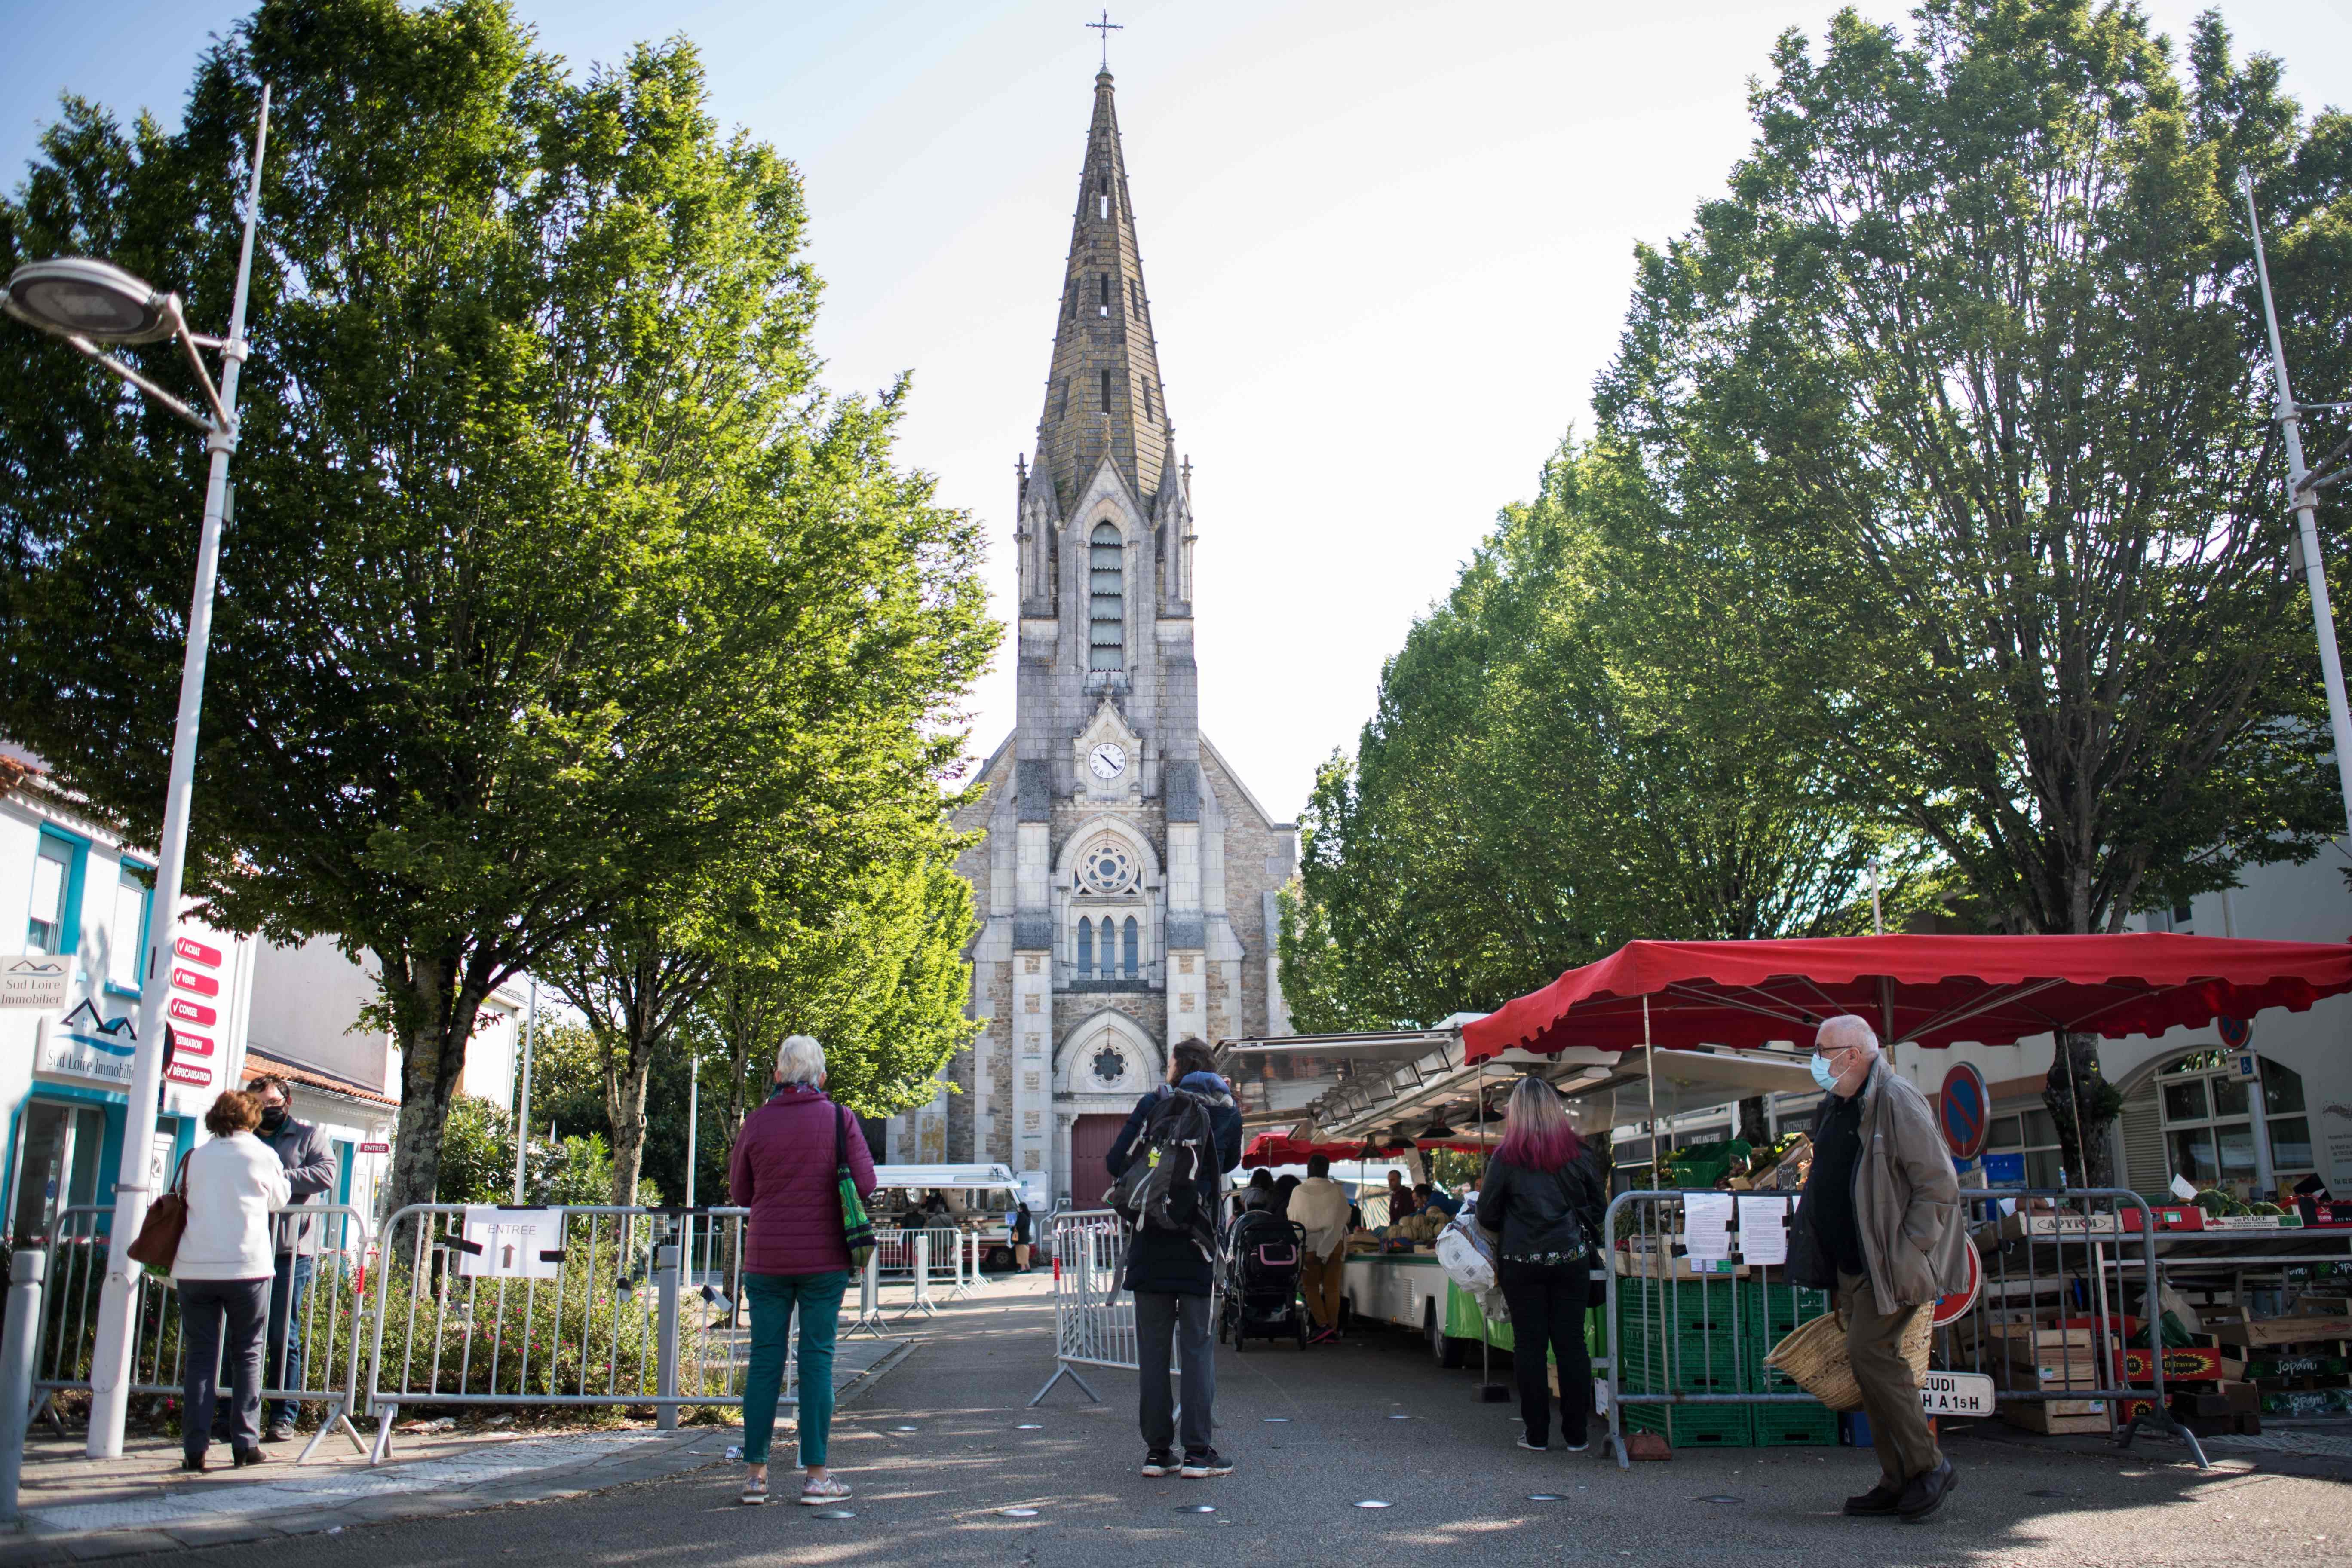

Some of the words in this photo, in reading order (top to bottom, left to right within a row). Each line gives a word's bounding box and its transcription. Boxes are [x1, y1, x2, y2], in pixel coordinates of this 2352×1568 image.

[184, 944, 201, 956] ACHAT
[6, 980, 26, 989] Sud
[31, 980, 60, 989] Loire
[0, 994, 62, 1004] Immobilier
[179, 1004, 198, 1017] CONSEIL
[176, 1035, 202, 1050] ESTIMATION
[48, 1049, 65, 1067] Sud
[68, 1053, 92, 1072] Loire
[95, 1058, 134, 1079] Immobili
[173, 1065, 210, 1082] DÉFISCALISATION
[488, 1224, 537, 1235] ENTREE
[2276, 1359, 2317, 1375] Jopami
[1922, 1377, 1955, 1392] EUDI
[1922, 1394, 1932, 1407] H
